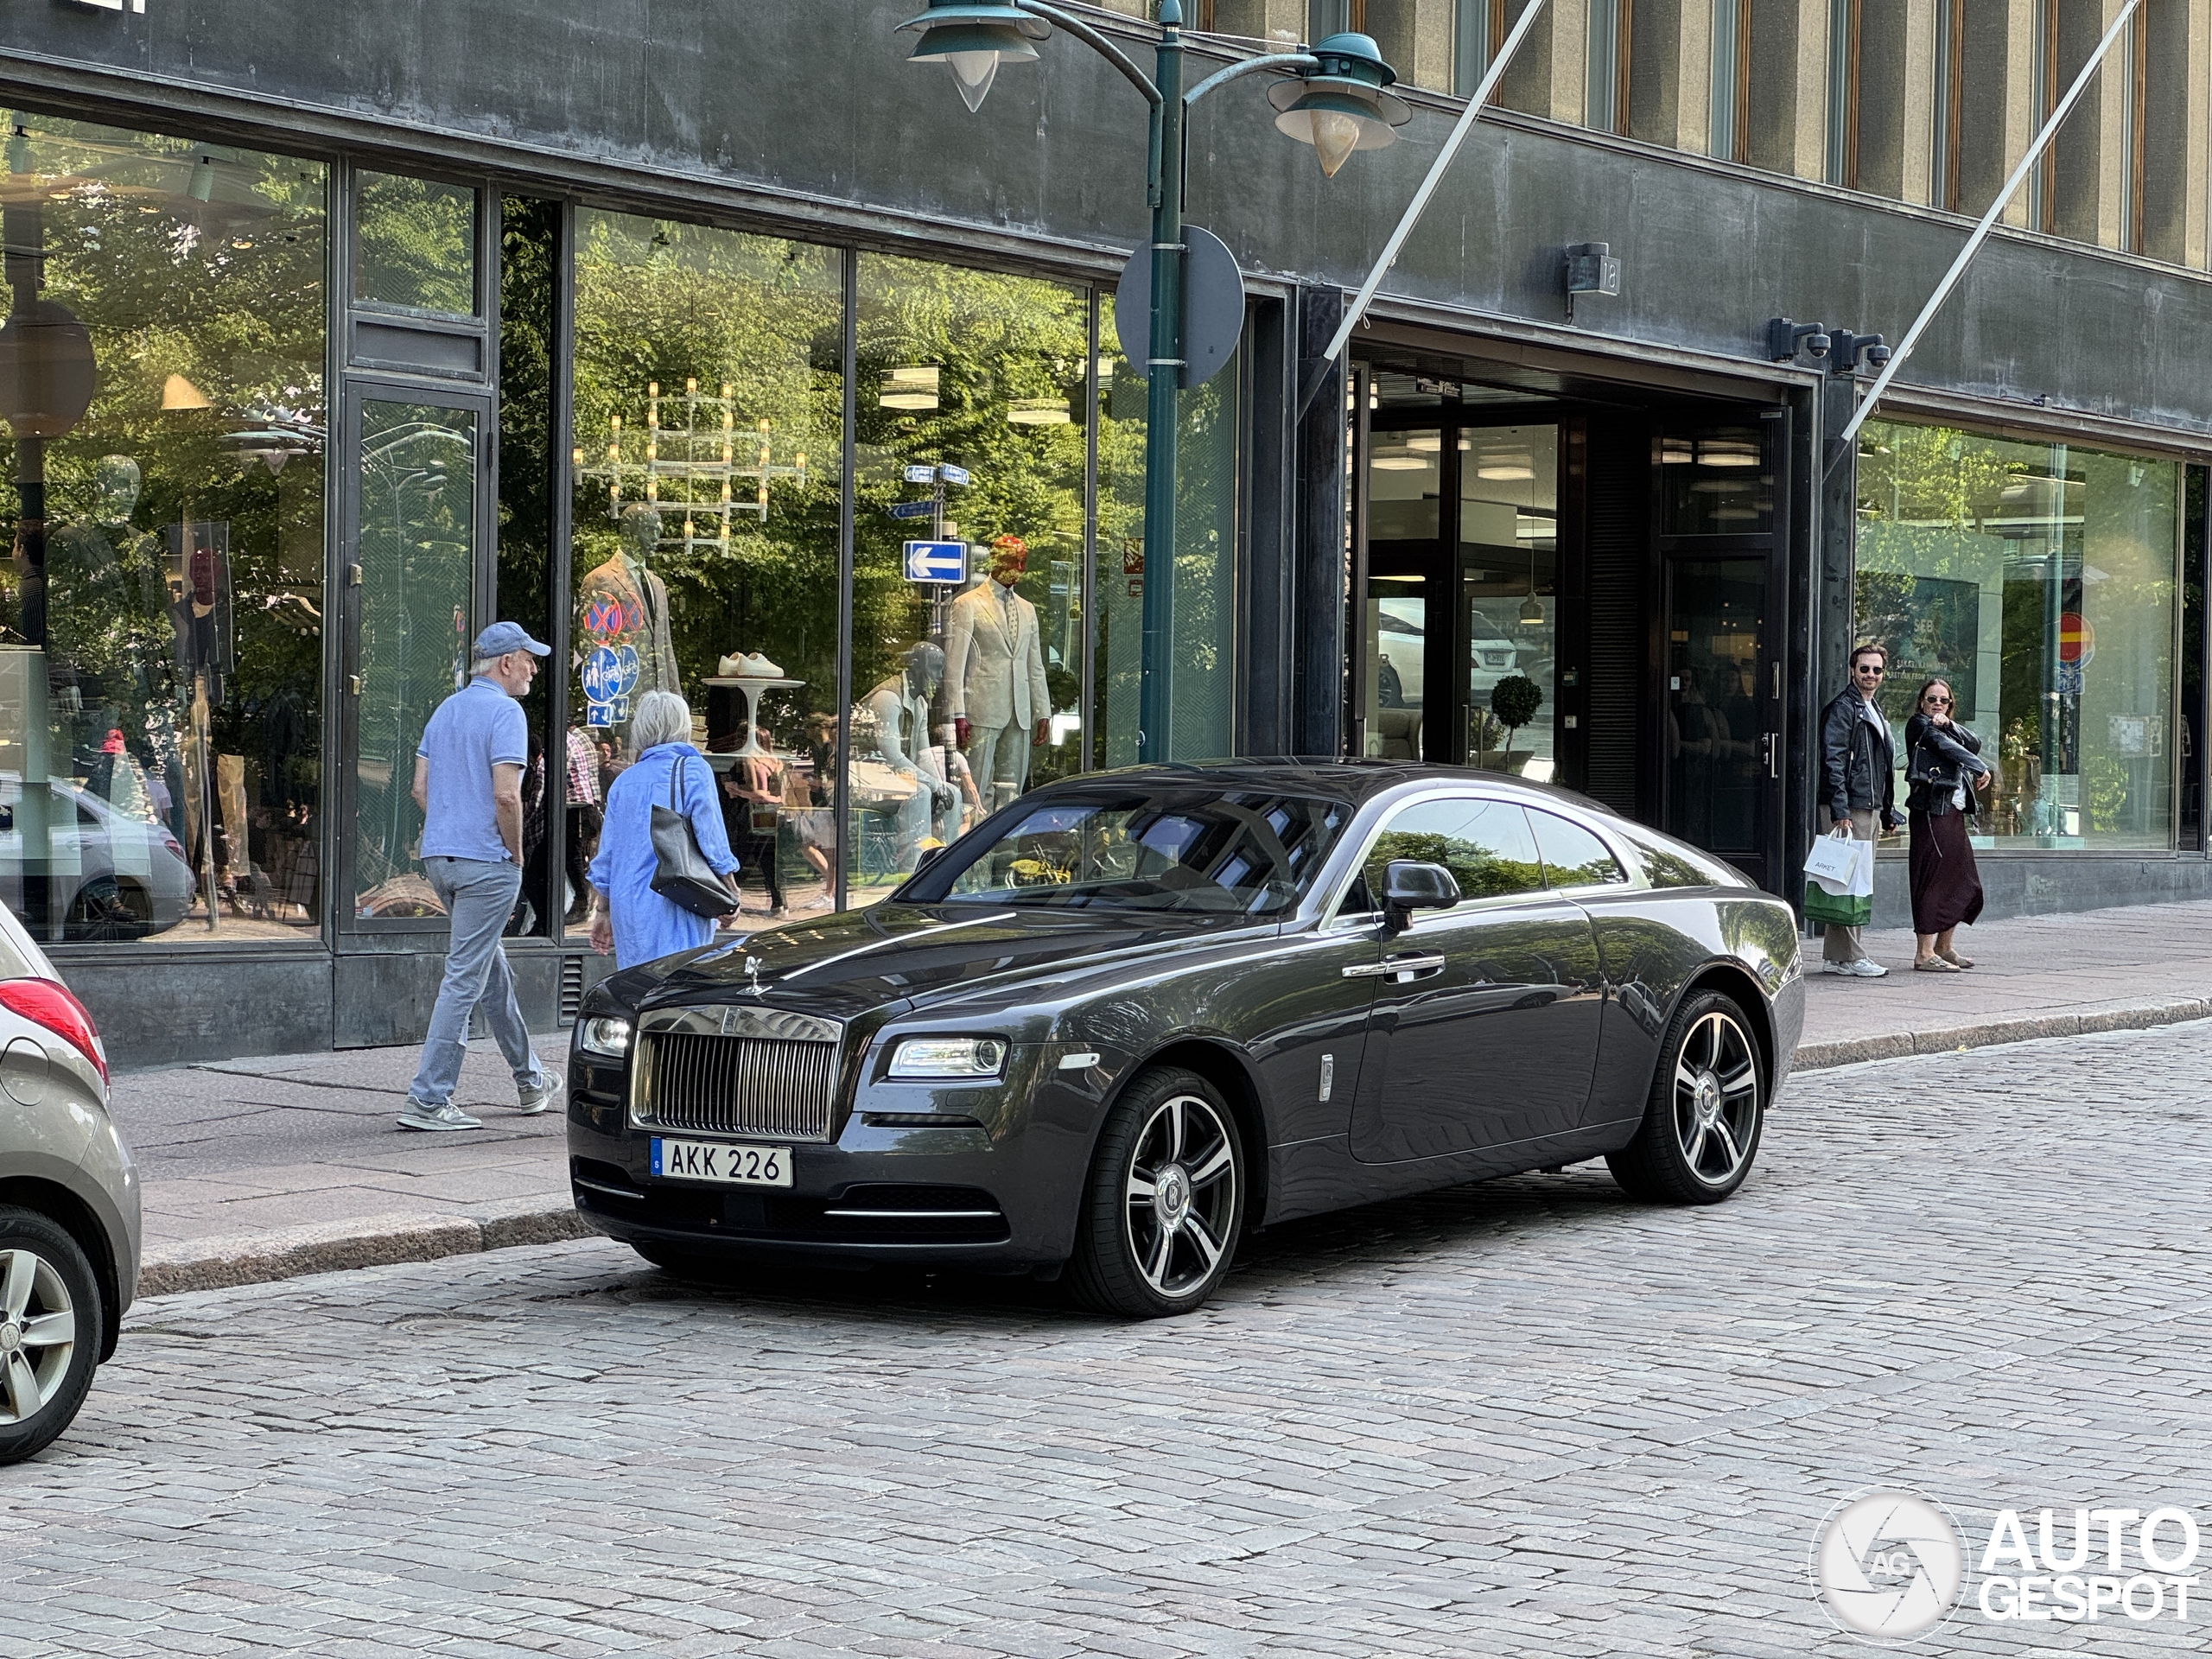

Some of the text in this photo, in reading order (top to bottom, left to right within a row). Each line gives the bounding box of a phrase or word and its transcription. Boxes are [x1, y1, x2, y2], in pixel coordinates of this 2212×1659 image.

[1815, 861, 1836, 872] ARKET
[654, 1144, 779, 1180] S AKK 226
